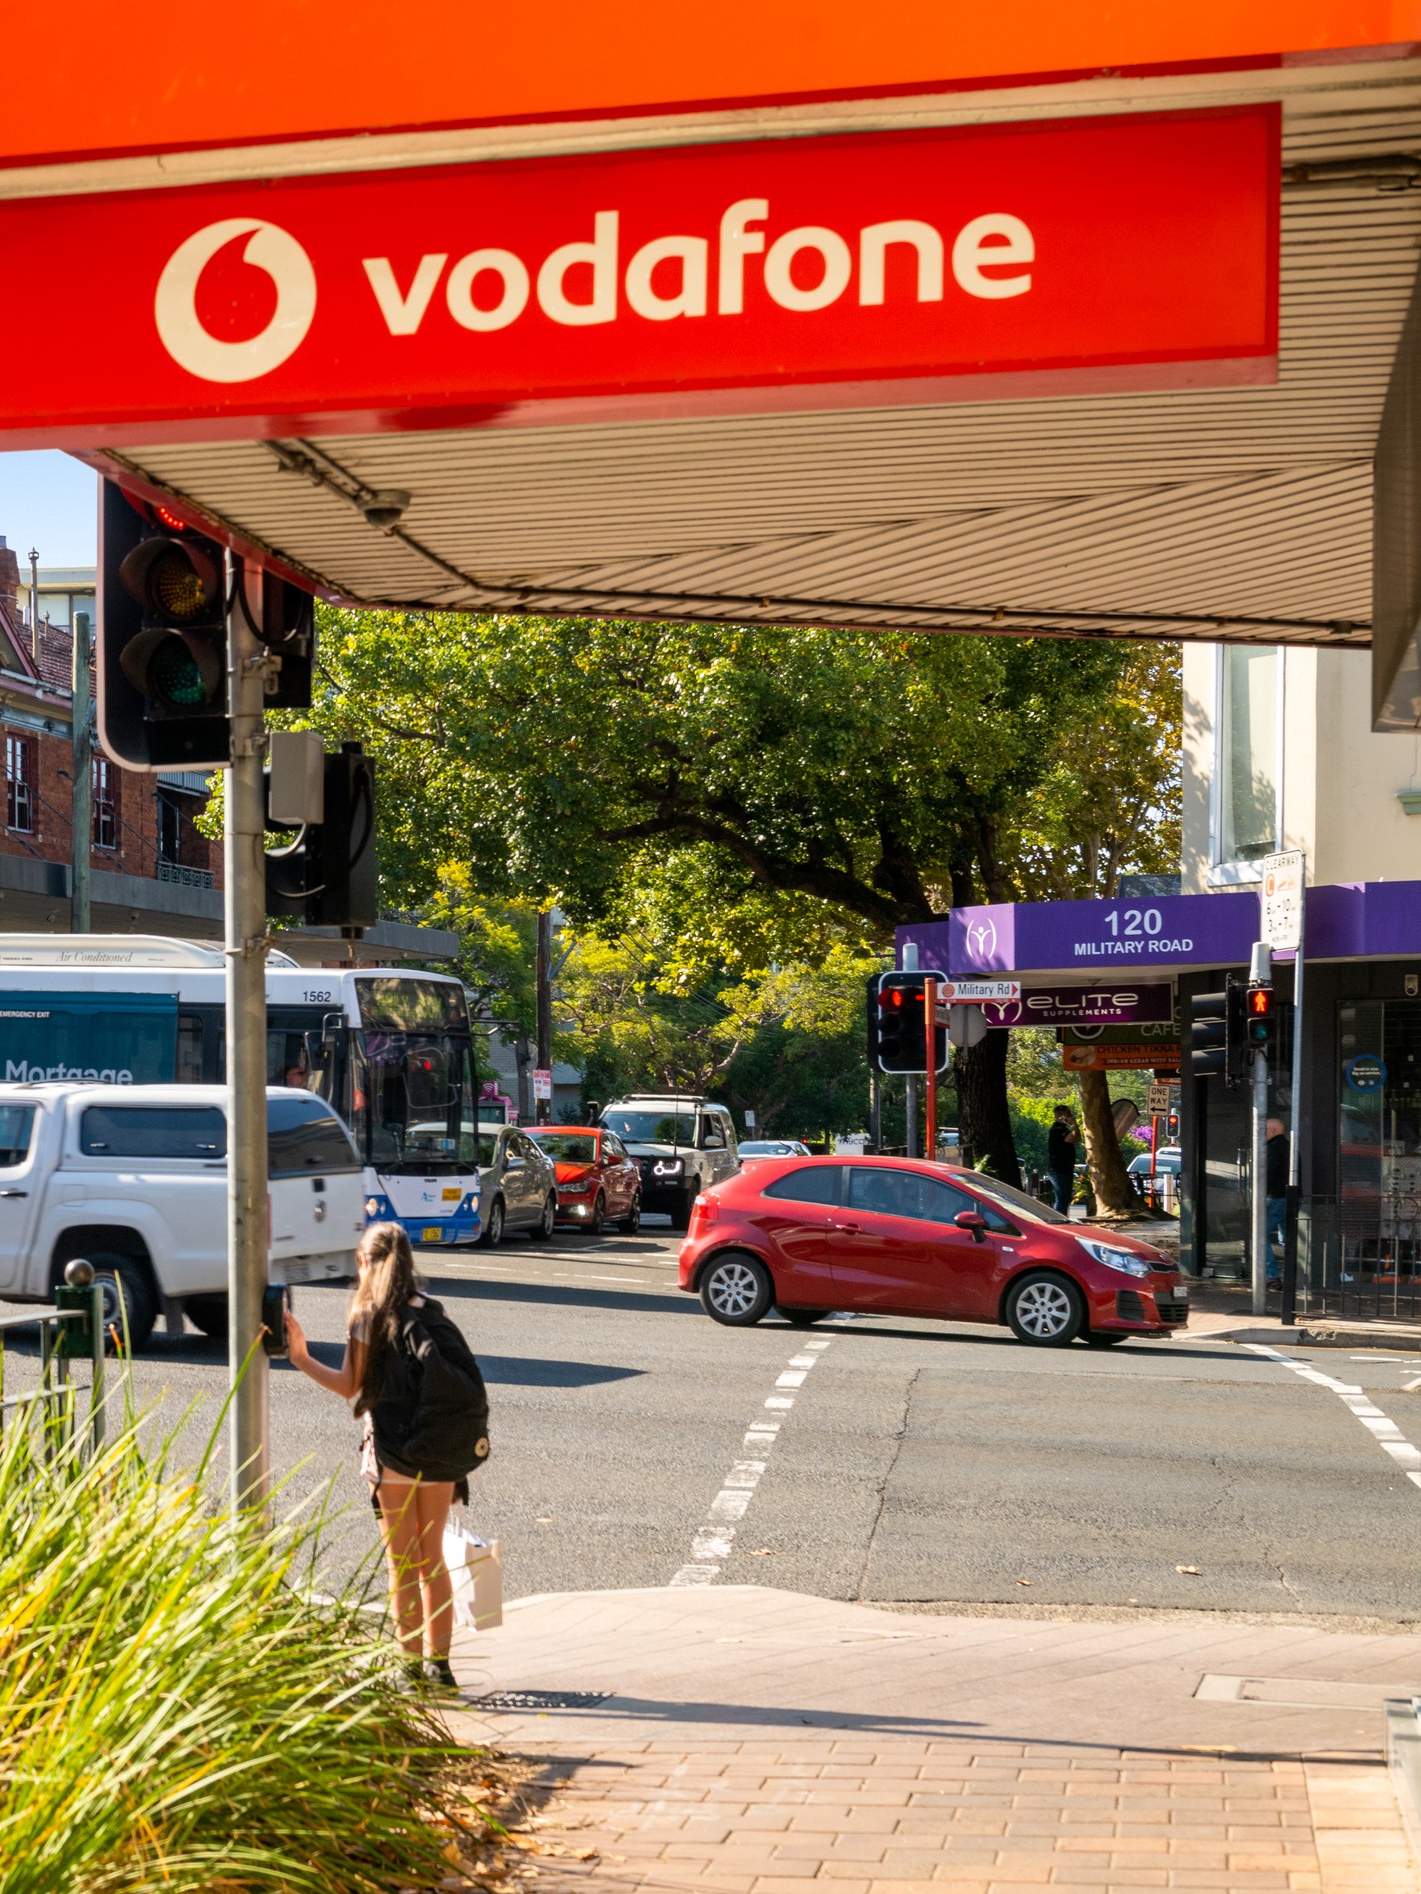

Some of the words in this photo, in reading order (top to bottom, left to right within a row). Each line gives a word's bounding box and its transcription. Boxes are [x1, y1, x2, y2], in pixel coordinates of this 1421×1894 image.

[362, 198, 1036, 337] vodafone
[1266, 856, 1299, 870] CLEARWAY
[1104, 908, 1163, 936] 120
[1074, 941, 1144, 955] MILITARY
[1148, 938, 1194, 953] ROAD
[55, 951, 73, 963] Air
[74, 951, 134, 963] Conditioned
[958, 984, 994, 996] Military
[997, 983, 1010, 995] Rd
[302, 991, 332, 1002] 1562
[0, 1010, 36, 1018] EMERGENCY
[37, 1010, 50, 1019] EXIT
[1043, 1008, 1122, 1017] SUPPLEMENTS
[1097, 1045, 1140, 1054] CHICKEN
[1144, 1044, 1173, 1053] TIKKA
[1151, 1087, 1167, 1096] ONE
[1150, 1097, 1167, 1105] WAY
